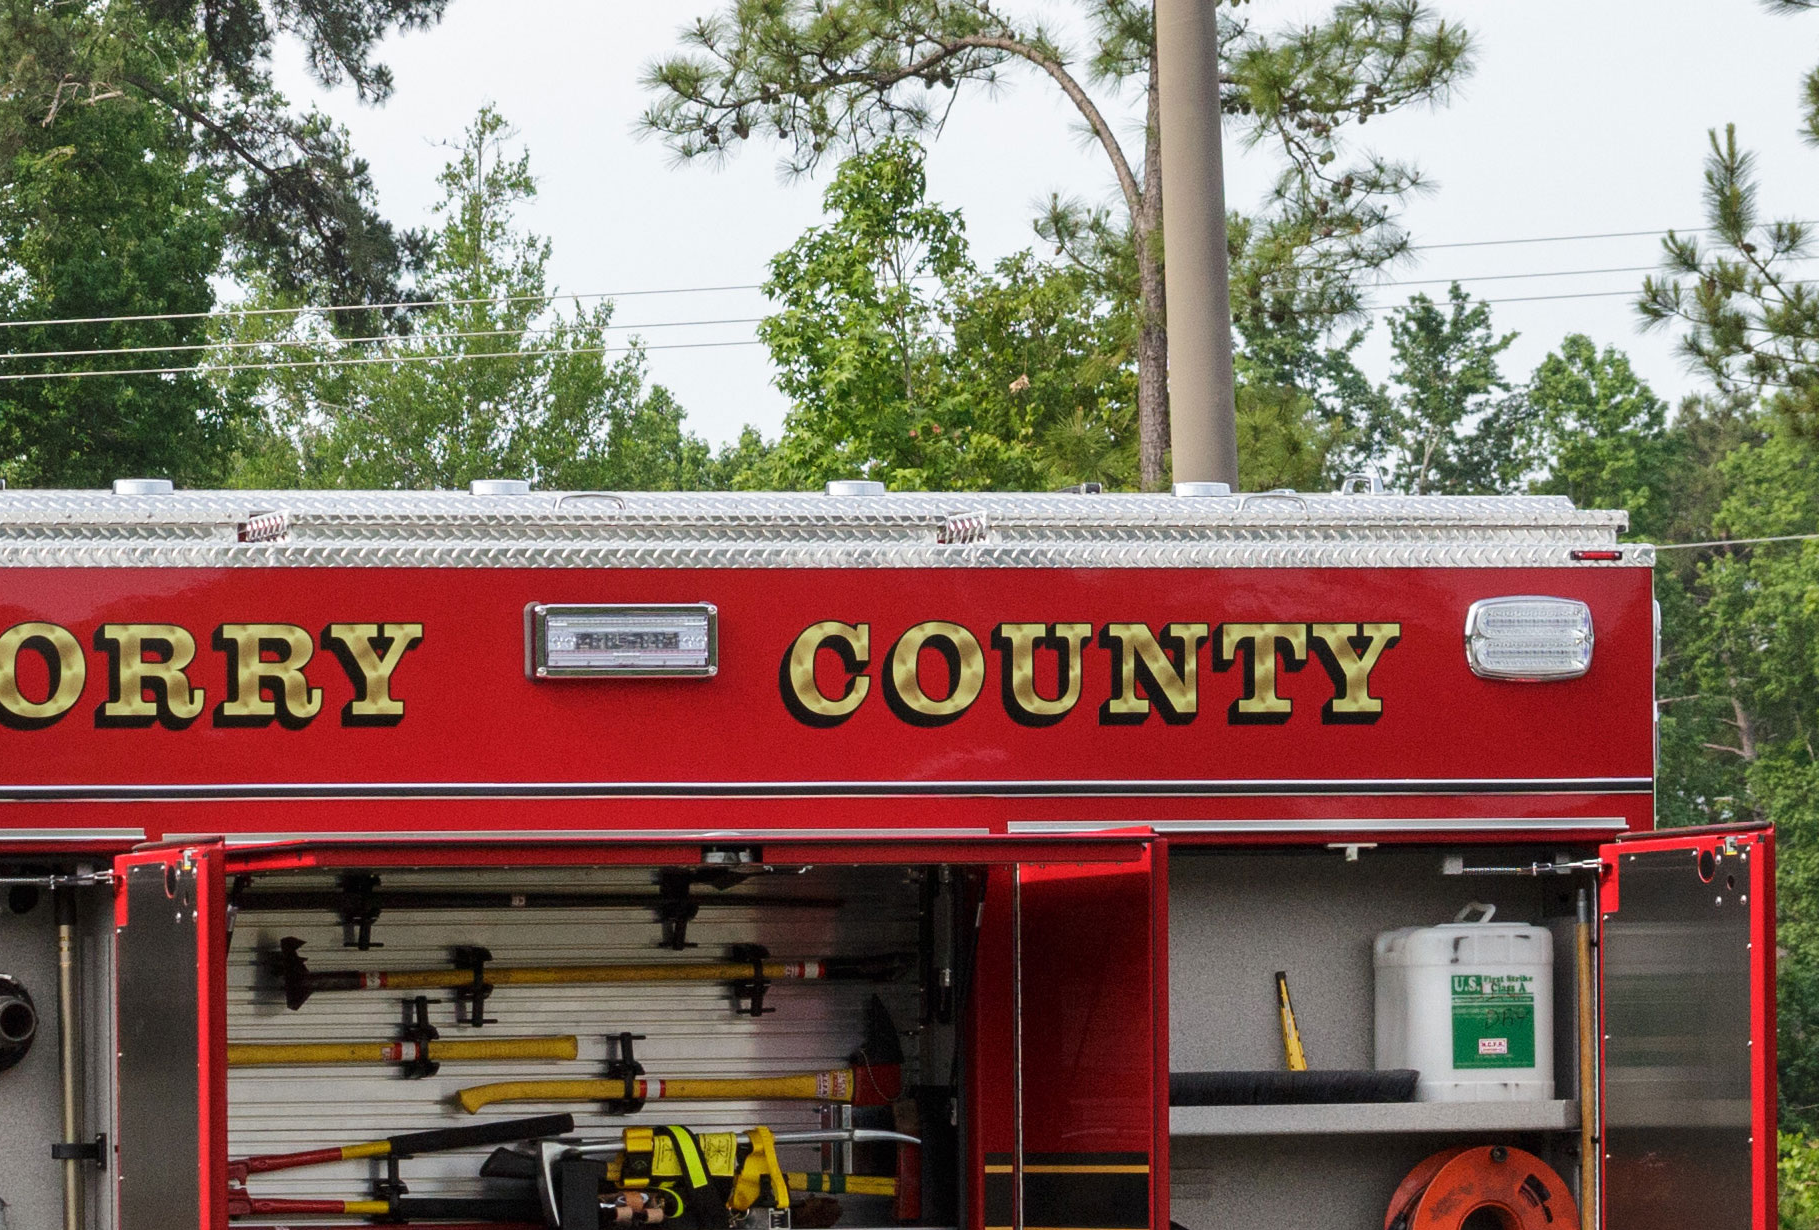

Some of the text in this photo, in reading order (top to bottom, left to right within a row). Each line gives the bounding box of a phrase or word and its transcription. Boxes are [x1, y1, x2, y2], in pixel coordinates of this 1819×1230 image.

[779, 619, 1401, 729] COUNTY
[1453, 974, 1533, 992] U.S. First Strike
[1491, 982, 1526, 993] Class A
